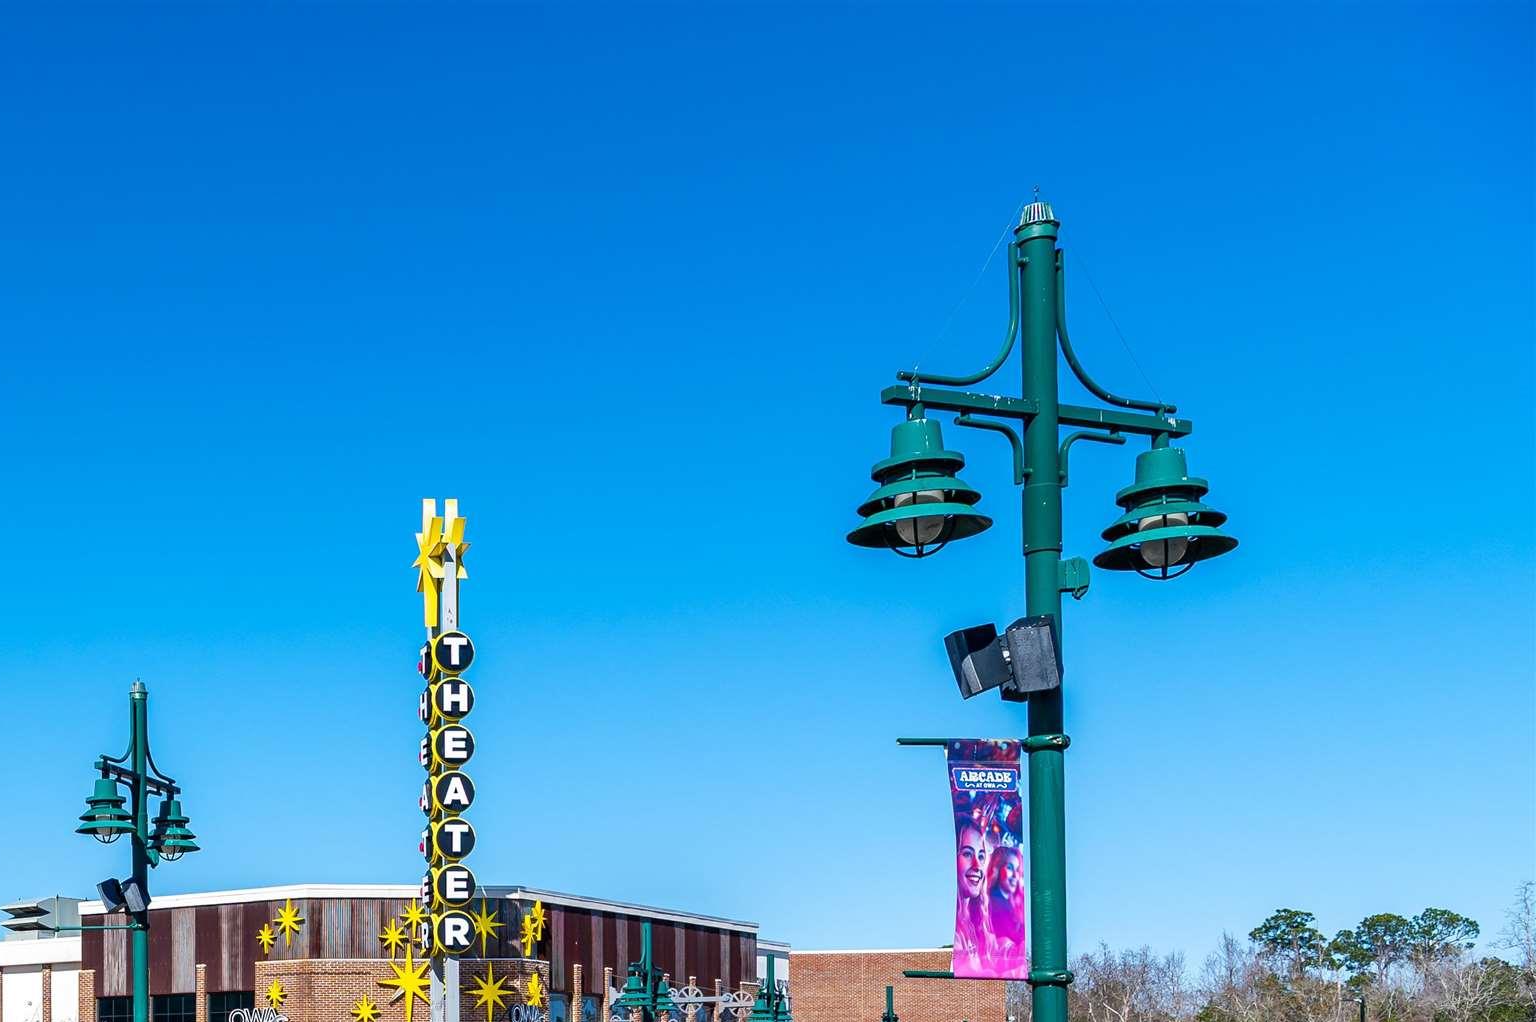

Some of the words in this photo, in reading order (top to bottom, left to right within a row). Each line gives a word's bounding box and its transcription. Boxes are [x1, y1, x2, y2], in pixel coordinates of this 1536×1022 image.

[418, 645, 430, 949] THEATER
[443, 636, 470, 946] THEATER
[959, 770, 1012, 783] ARCADE
